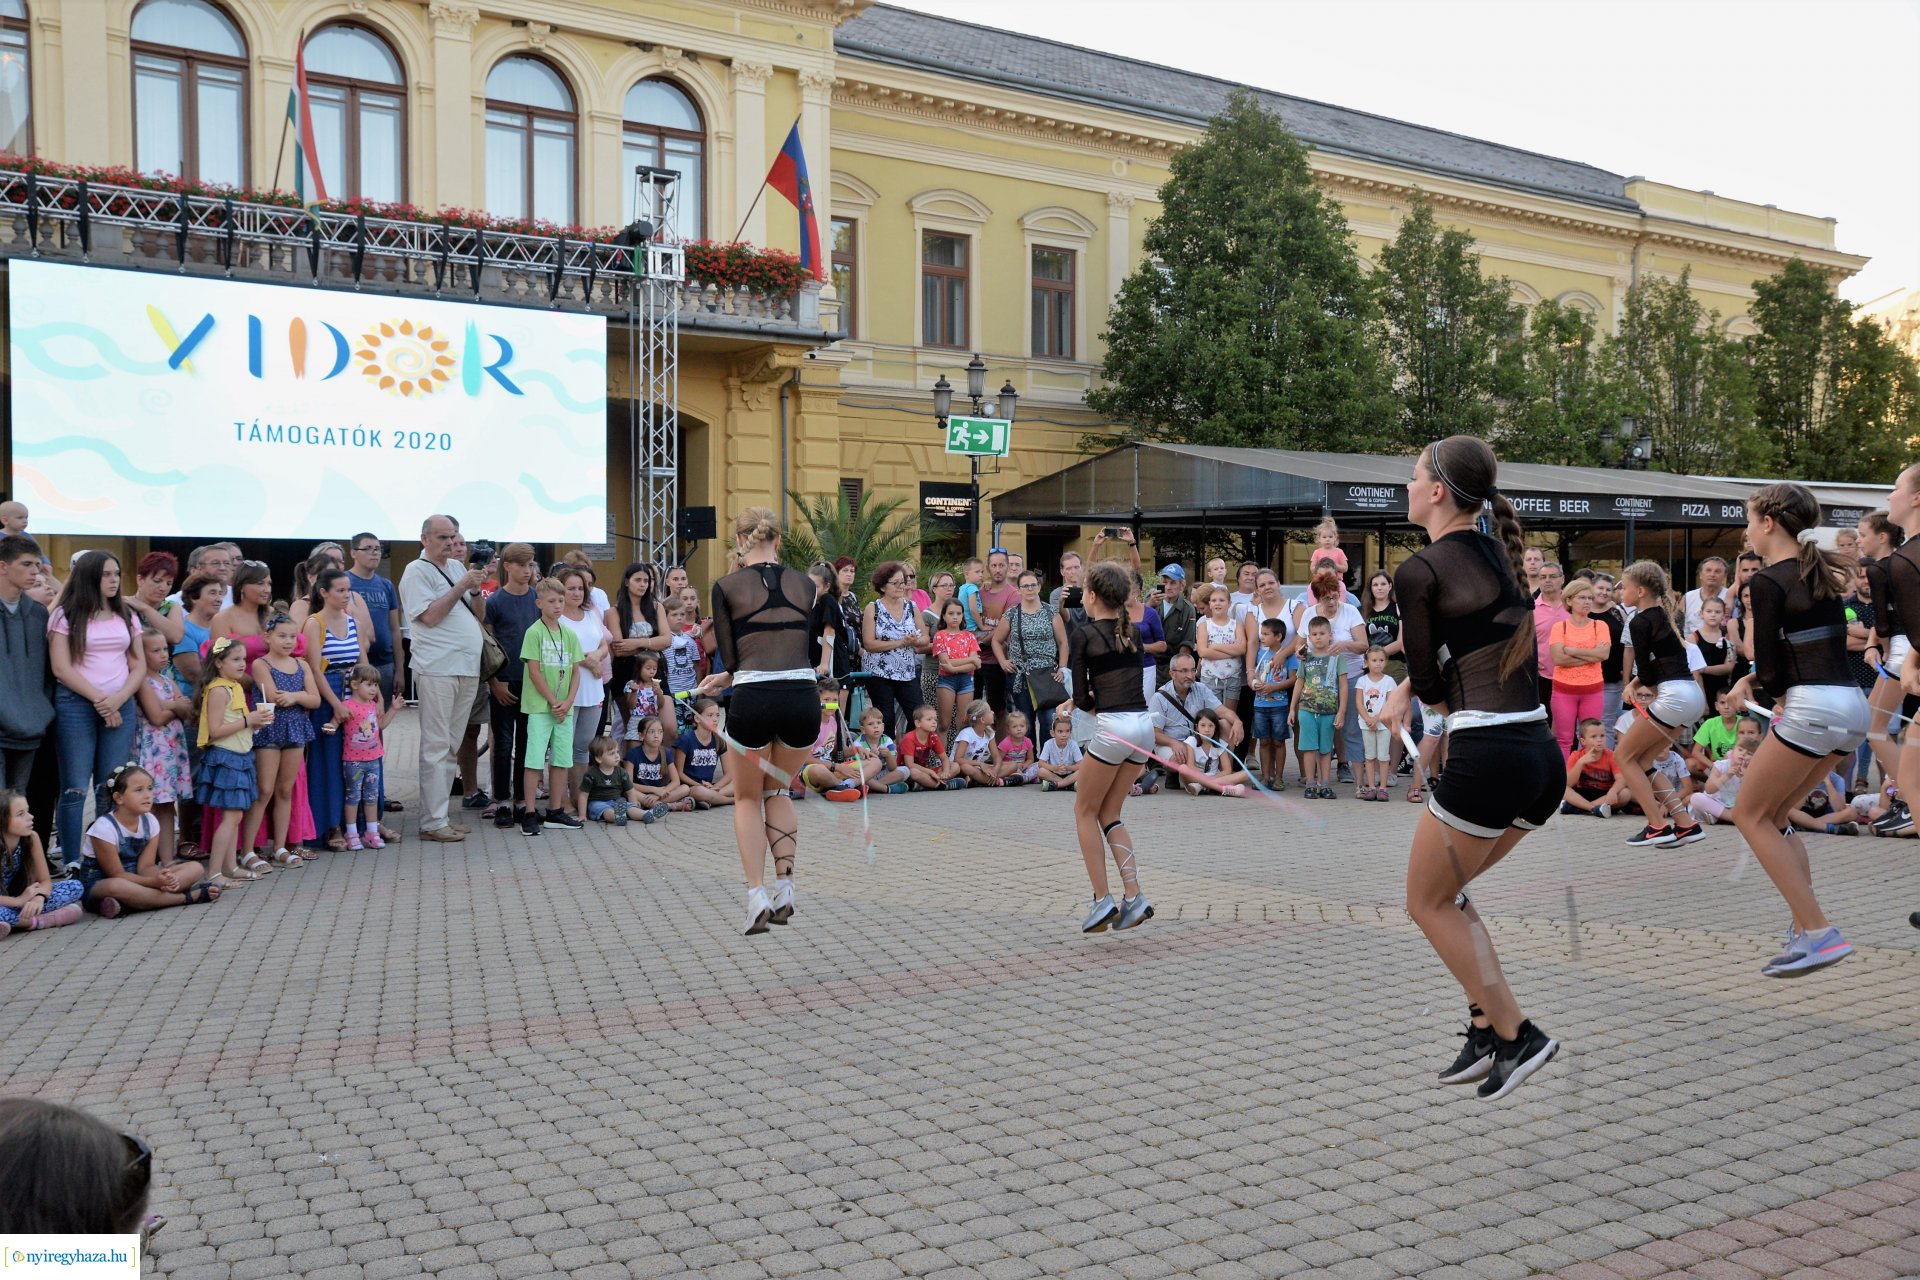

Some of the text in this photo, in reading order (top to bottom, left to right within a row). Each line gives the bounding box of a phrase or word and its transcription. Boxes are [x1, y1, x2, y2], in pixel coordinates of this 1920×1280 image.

[146, 303, 525, 398] VIDOR
[234, 419, 452, 451] TÁMOGATÓK 2020
[1349, 486, 1395, 498] CONTINENT
[1559, 500, 1590, 513] BEER
[1615, 497, 1652, 508] CONTINENT
[1682, 503, 1744, 518] PIZZA BOR
[1832, 508, 1863, 518] CONTINENT
